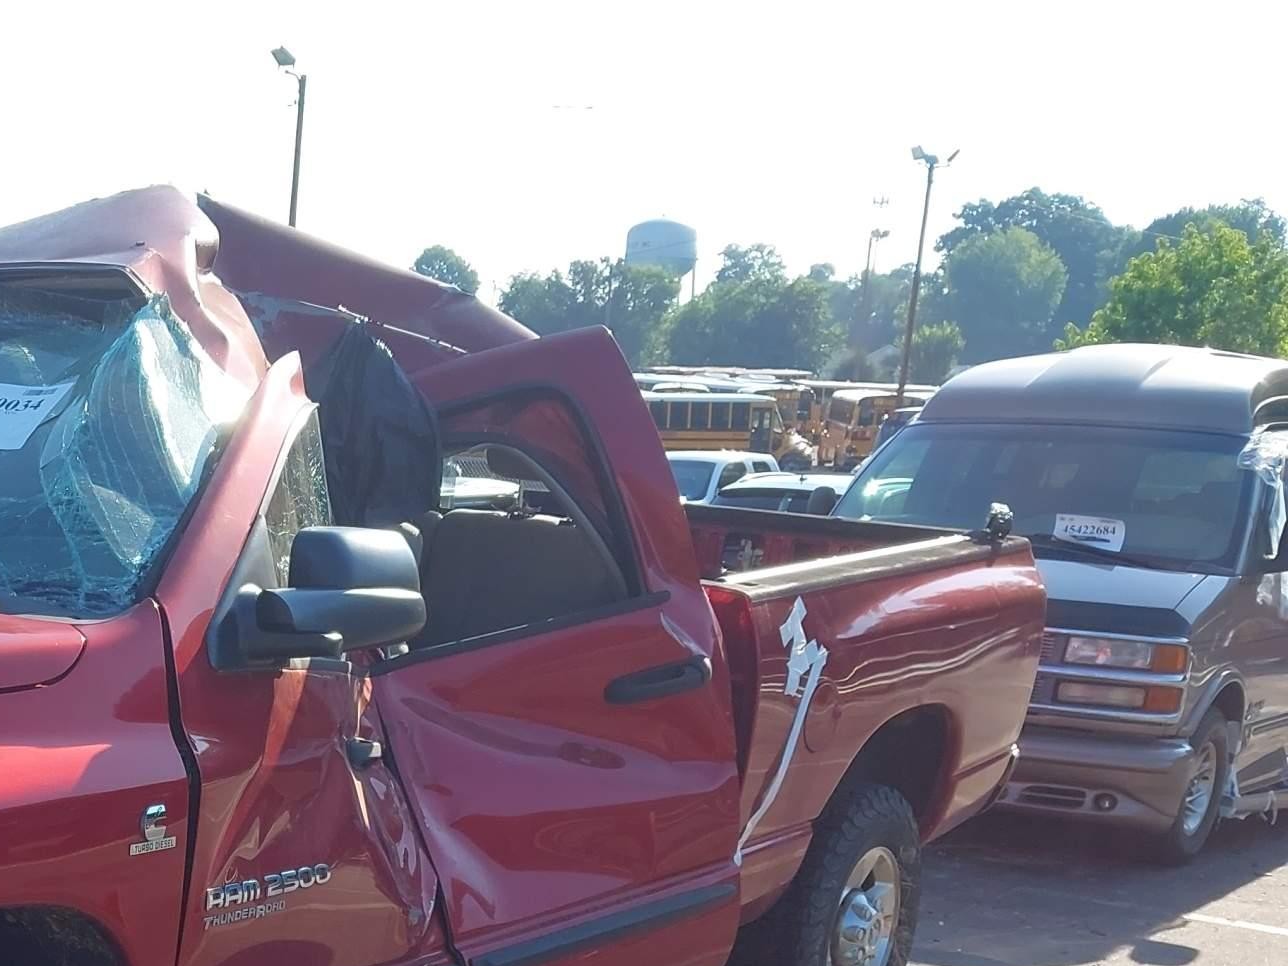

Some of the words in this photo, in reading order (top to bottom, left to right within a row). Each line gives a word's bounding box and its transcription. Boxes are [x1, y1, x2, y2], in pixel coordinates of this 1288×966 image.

[1064, 524, 1116, 535] 45422684
[155, 839, 174, 850] DIESEL
[206, 879, 261, 912] RAM
[263, 863, 332, 897] 2500
